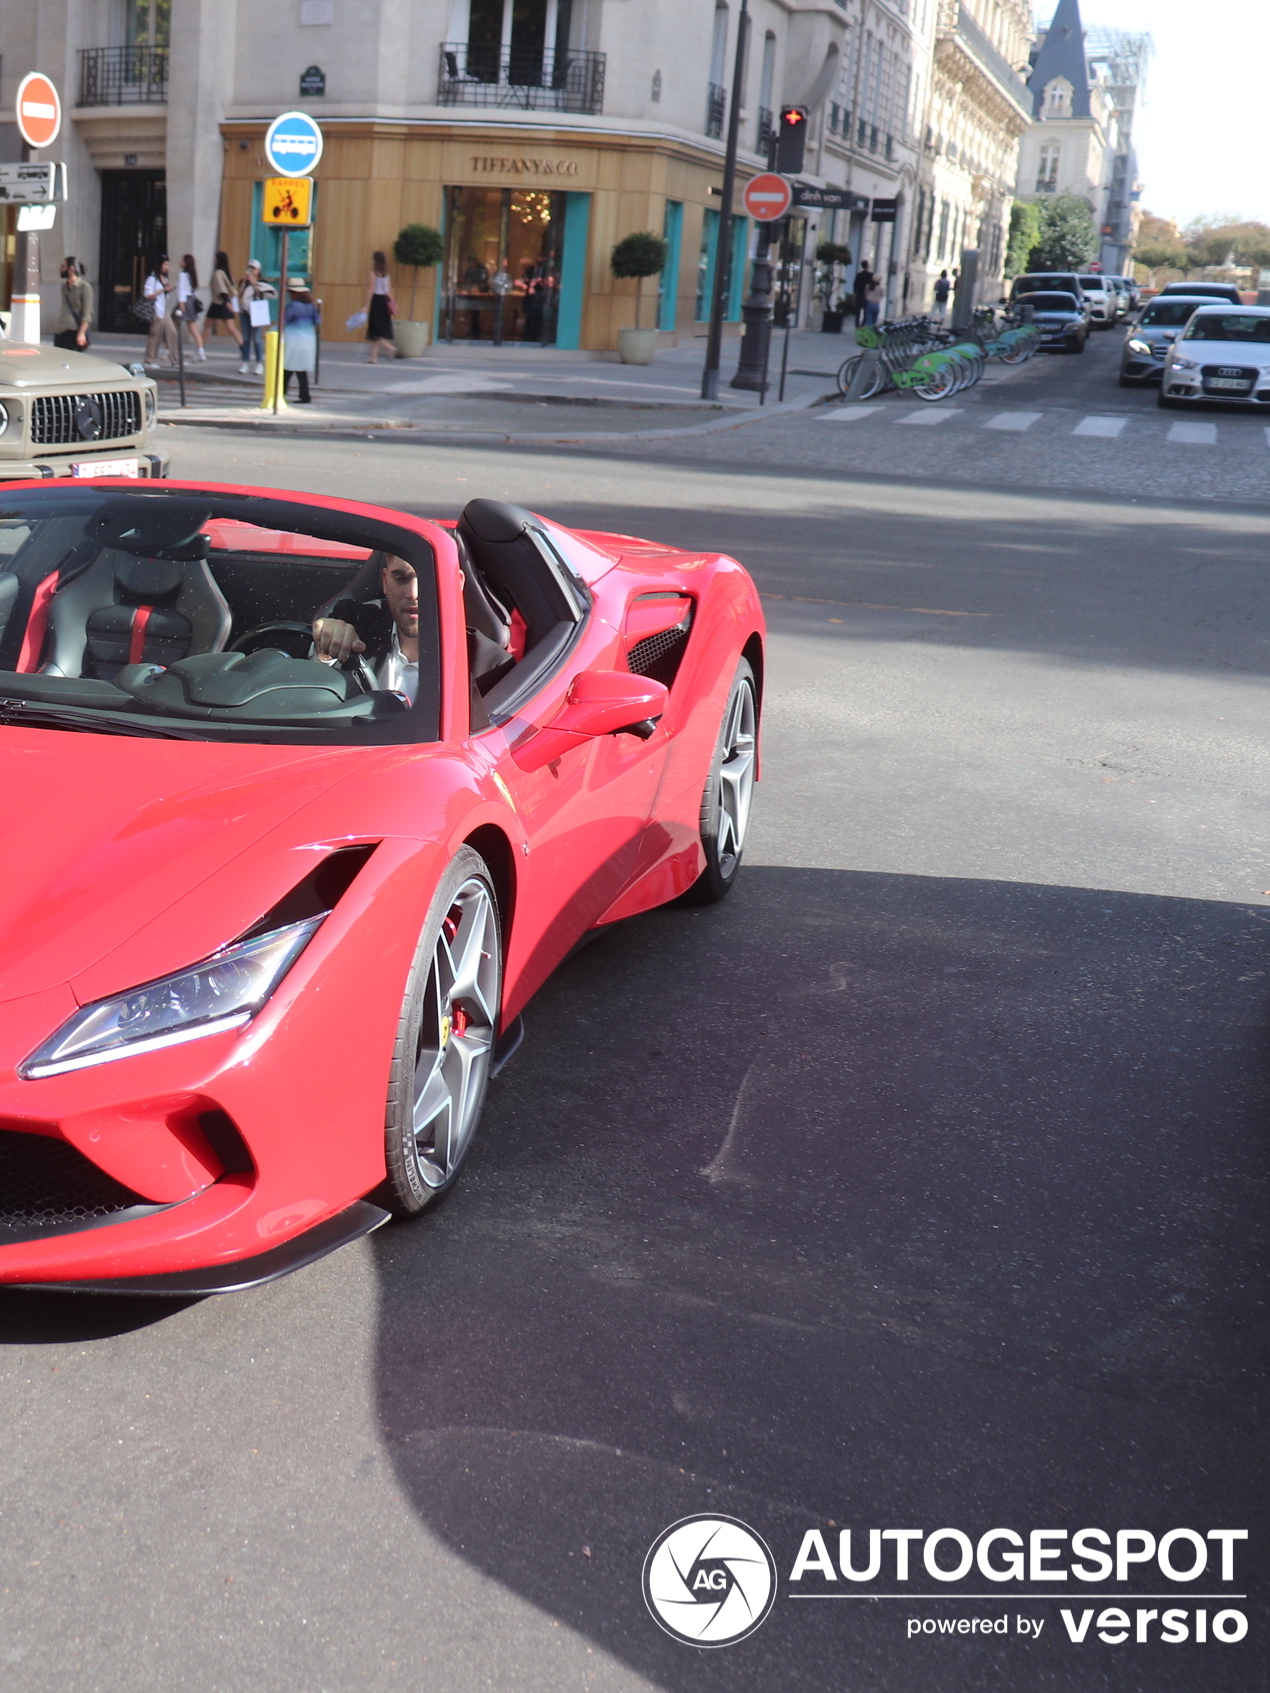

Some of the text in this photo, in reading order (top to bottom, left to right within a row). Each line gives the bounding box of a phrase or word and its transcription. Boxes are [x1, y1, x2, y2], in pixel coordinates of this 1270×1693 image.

[271, 178, 306, 188] RAPPEL
[822, 194, 842, 203] van
[404, 1156, 425, 1203] MICHELIN
